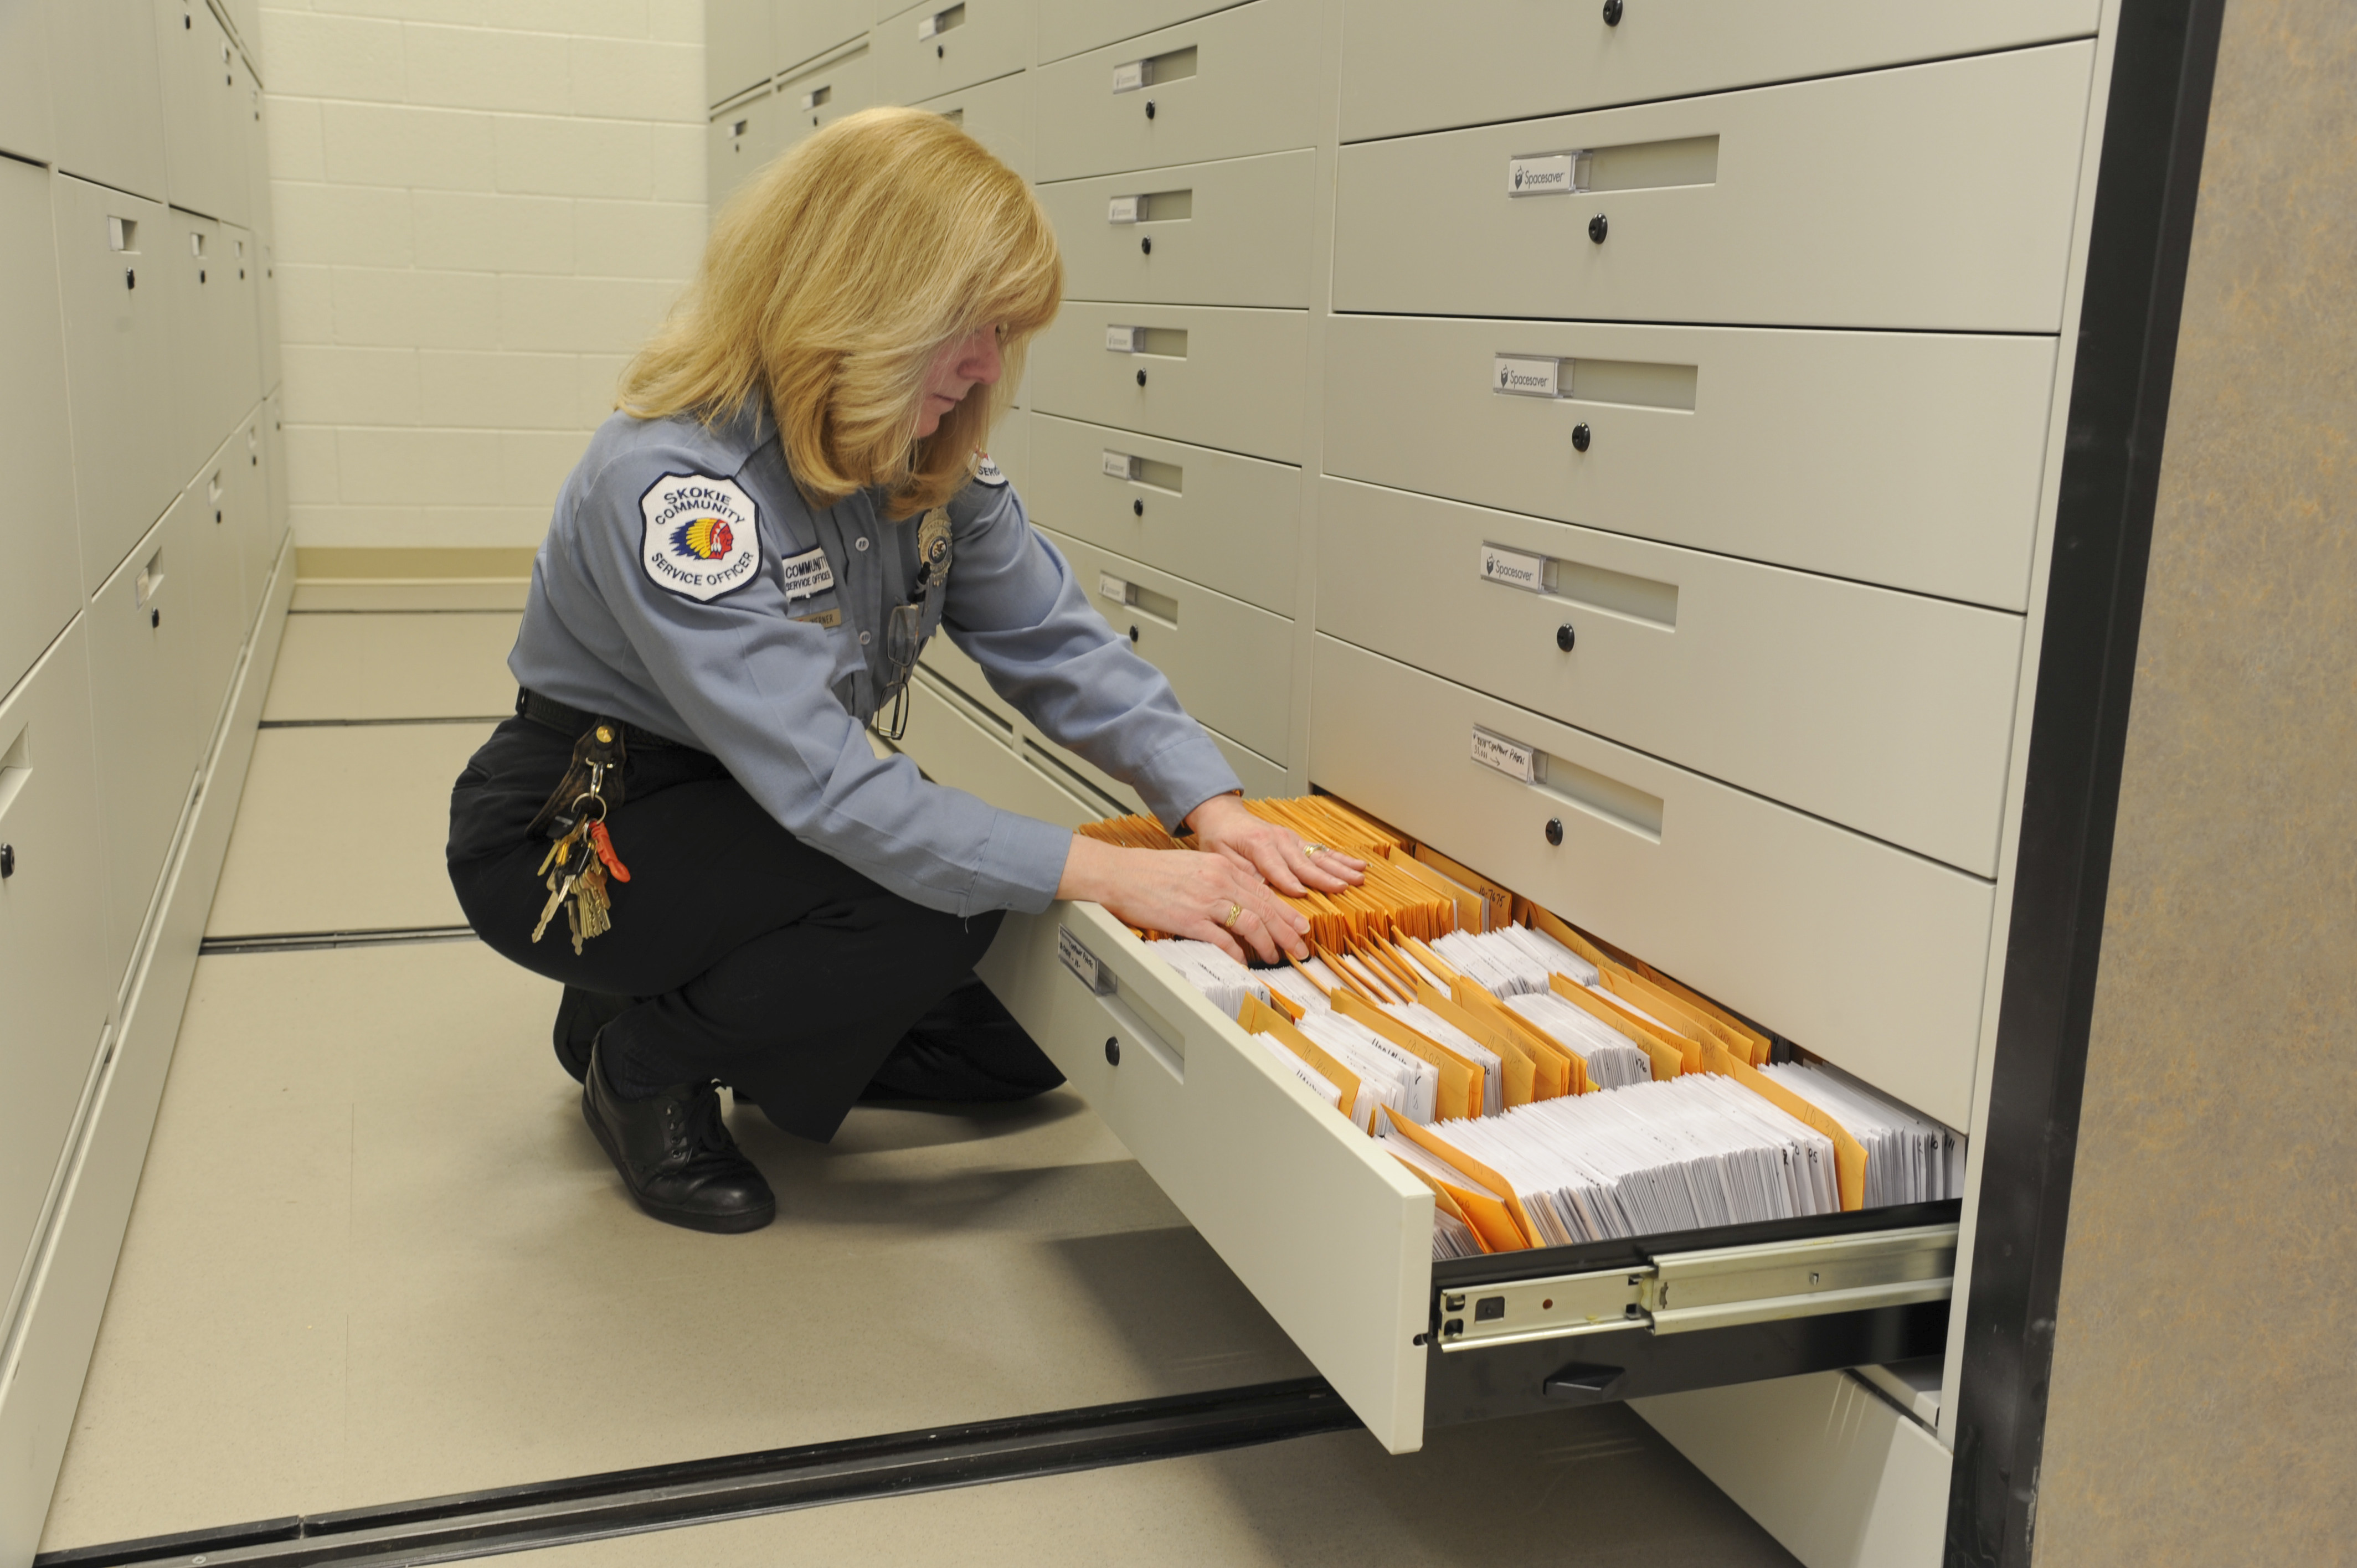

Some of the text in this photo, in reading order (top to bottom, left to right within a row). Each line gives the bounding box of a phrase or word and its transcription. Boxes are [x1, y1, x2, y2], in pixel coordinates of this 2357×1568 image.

[1525, 170, 1563, 189] Spacesaver
[1510, 370, 1547, 389] Spacesaver
[664, 487, 732, 506] SKOKIE
[655, 500, 745, 525] COMMUNITY
[652, 551, 754, 585] SERVICE OFFICER
[1496, 560, 1532, 581] Spacesaver
[785, 576, 811, 591] SERVICE
